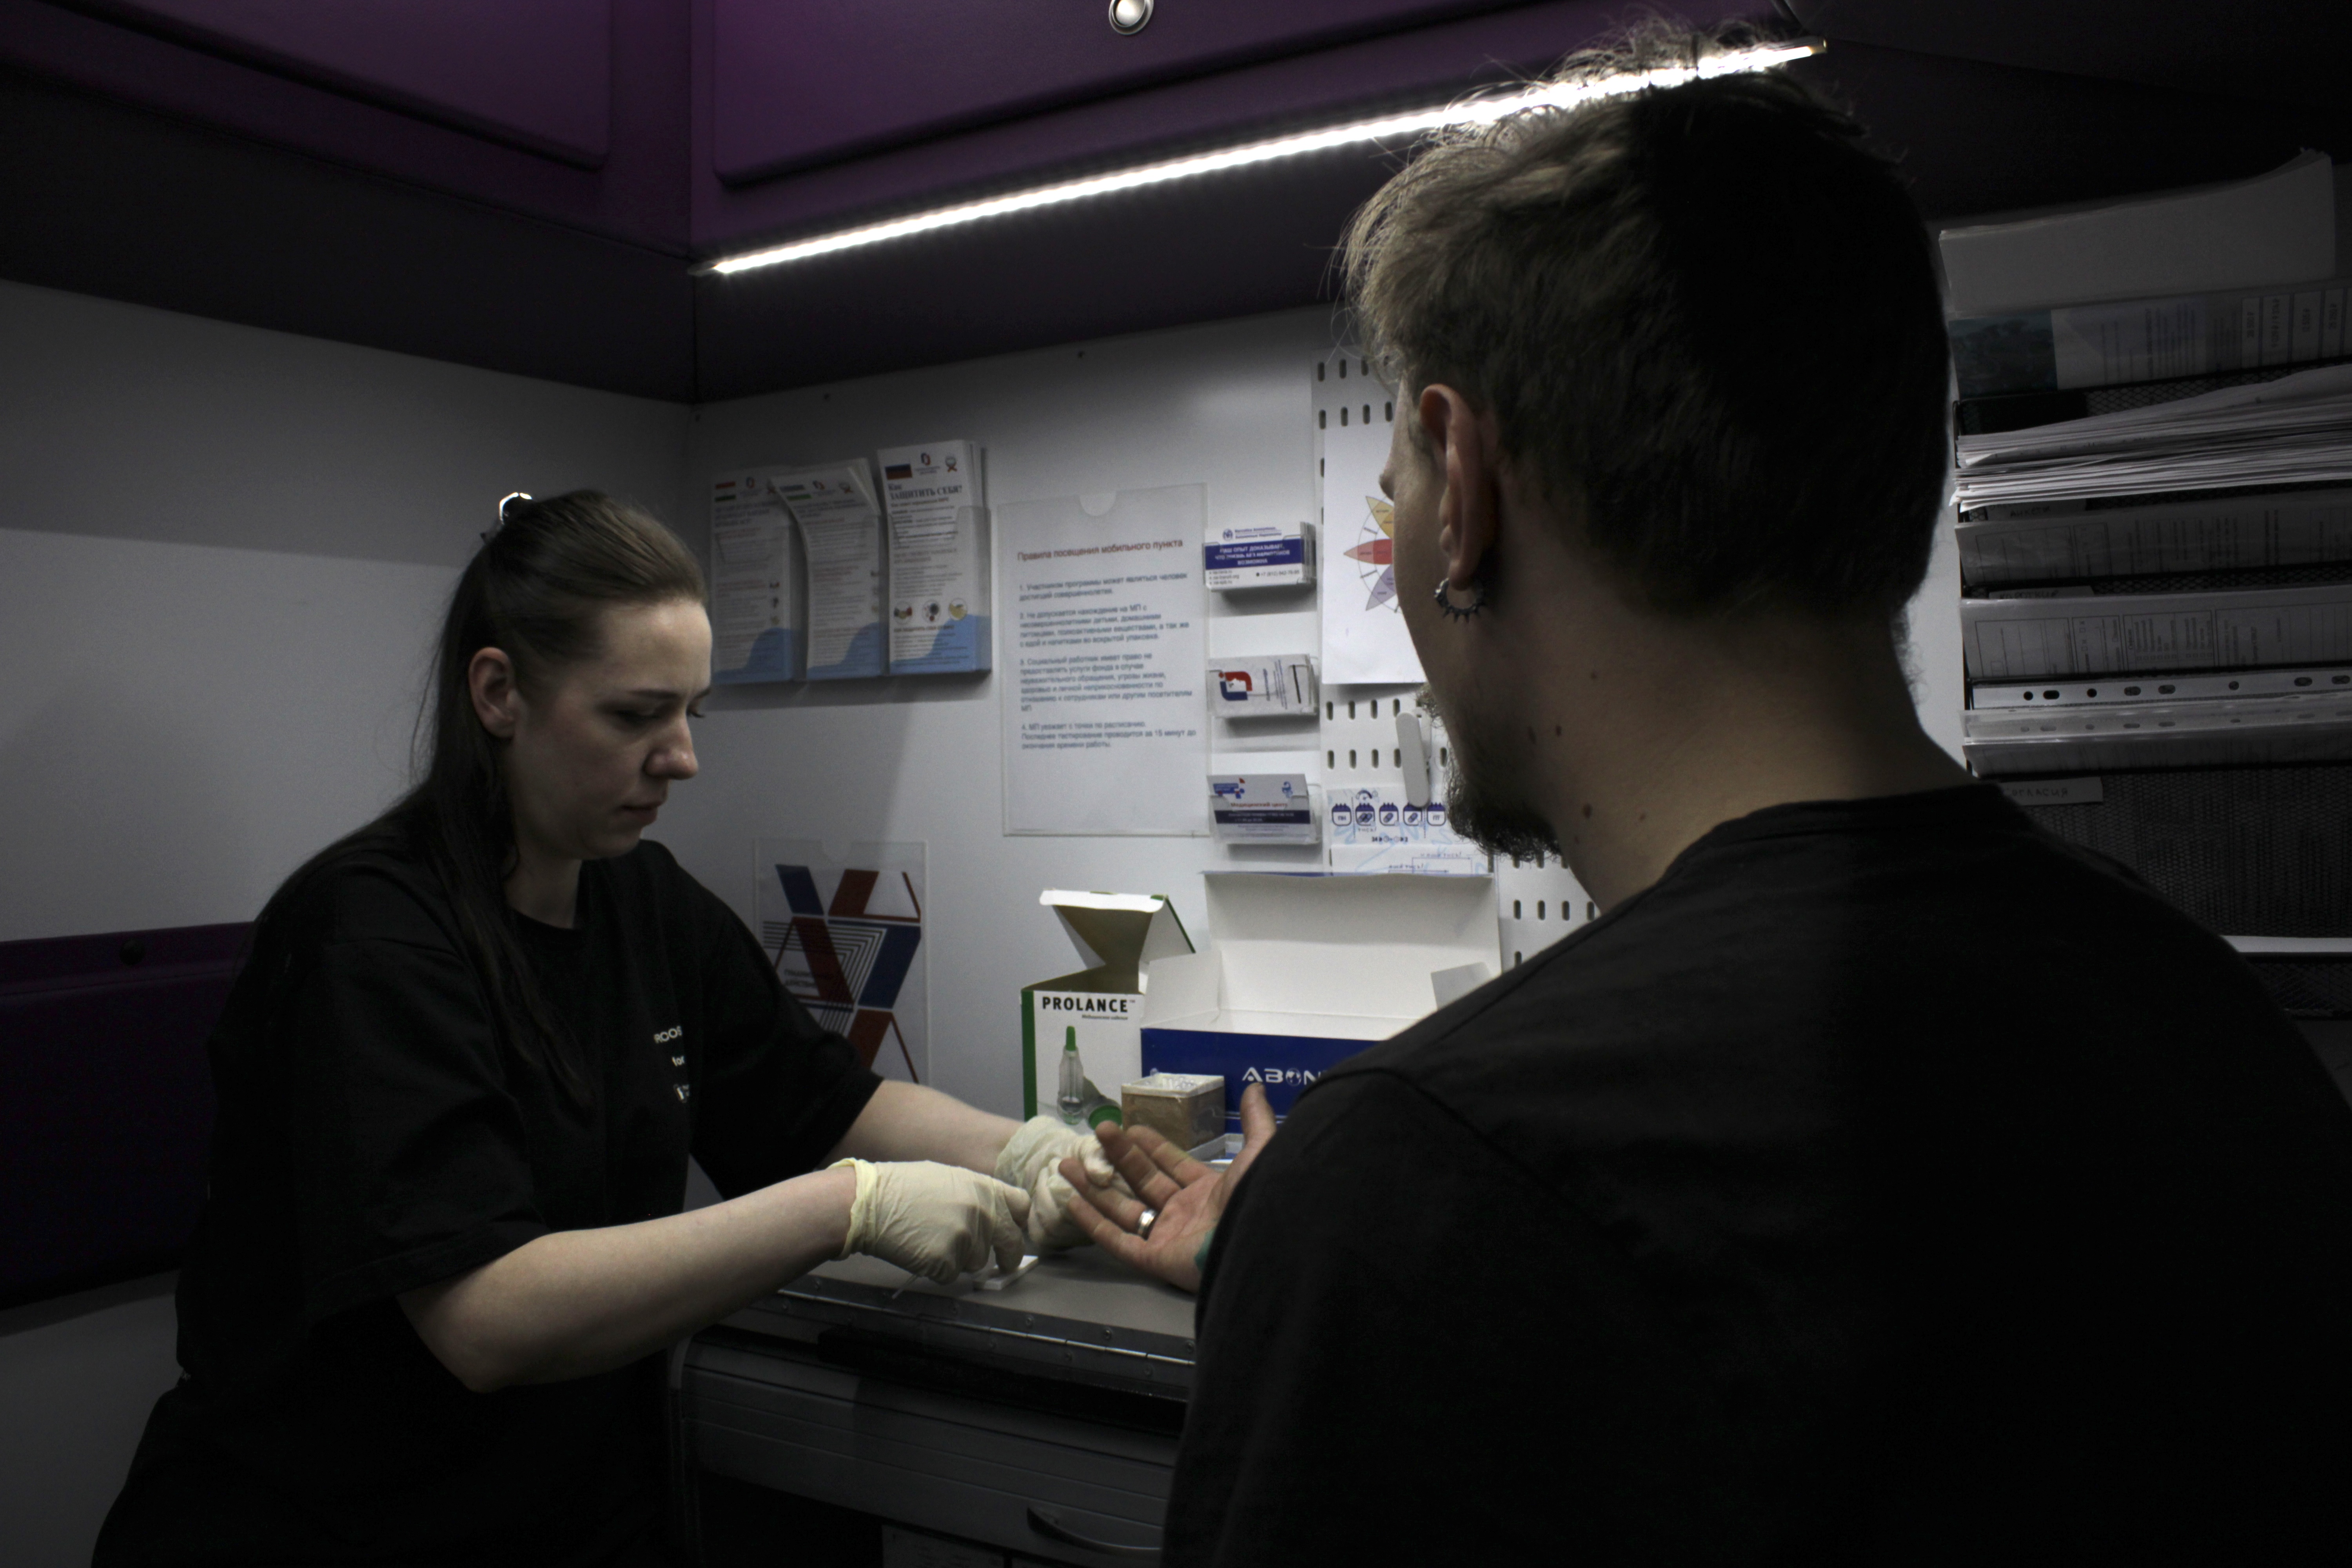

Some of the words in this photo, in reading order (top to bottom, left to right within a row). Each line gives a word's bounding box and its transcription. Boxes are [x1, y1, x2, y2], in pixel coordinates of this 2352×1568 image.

[890, 488, 935, 500] ЗАЩИТИТЬ
[937, 485, 963, 495] СЕБЯ?
[1018, 552, 1051, 562] Правила
[1054, 546, 1099, 557] посещения
[1101, 543, 1150, 554] мобильного
[1153, 539, 1183, 550] пункта
[2007, 788, 2068, 798] ОГЛАСИЯ
[1042, 996, 1127, 1012] PROLANCE
